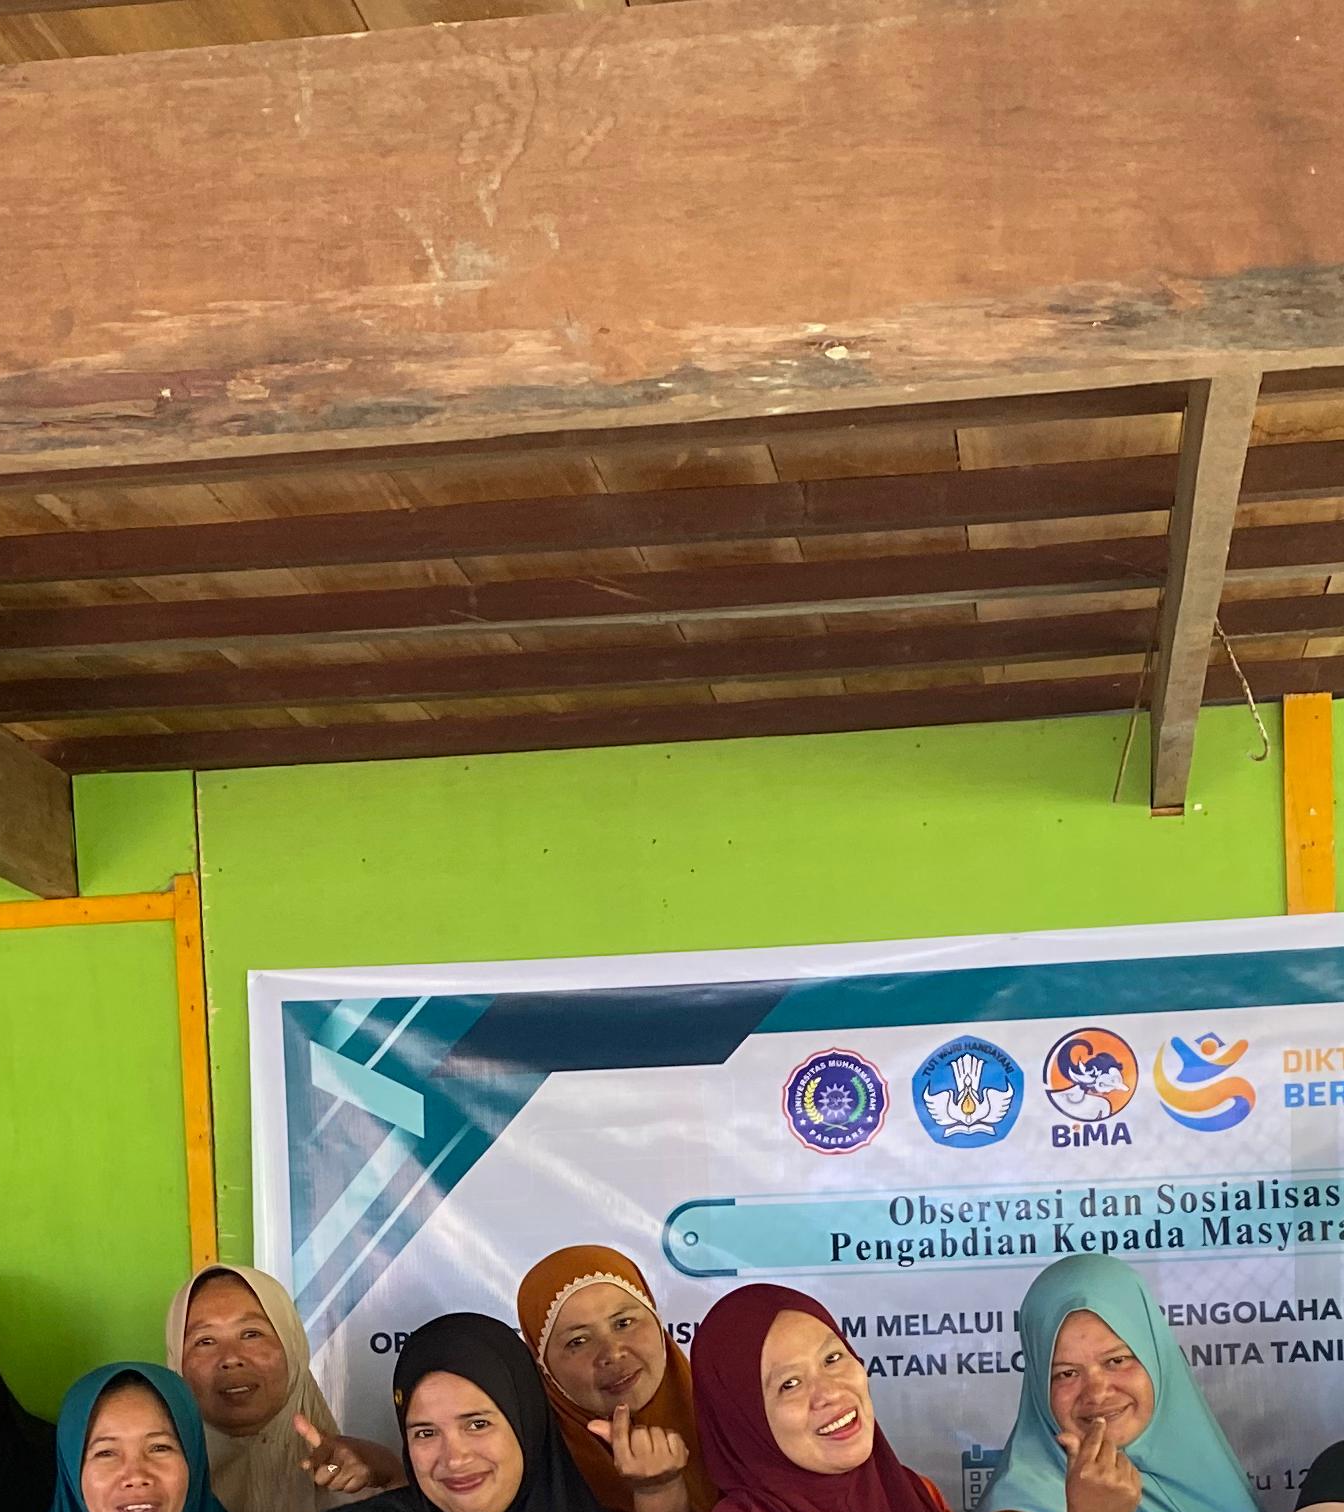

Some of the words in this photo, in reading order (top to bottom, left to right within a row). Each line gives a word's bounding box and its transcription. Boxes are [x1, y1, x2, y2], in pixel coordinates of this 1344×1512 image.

[922, 1058, 940, 1076] TUT
[938, 1043, 962, 1060] WURI
[964, 1042, 1014, 1074] HANDAYANI
[795, 1062, 827, 1114] UNIVERSITAS
[828, 1059, 876, 1111] MUHAMMADIYAH
[809, 1127, 864, 1145] PAREPARE
[888, 1188, 1064, 1226] Observasi
[1079, 1187, 1143, 1218] dan
[830, 1226, 1038, 1267] Pengabdian
[1053, 1219, 1186, 1256] Kepada
[876, 1310, 1003, 1338] MELALUI
[860, 1352, 948, 1378] ATAN
[956, 1350, 1026, 1375] KELO
[1179, 1341, 1265, 1367] NITA
[1270, 1338, 1344, 1364] TANI
